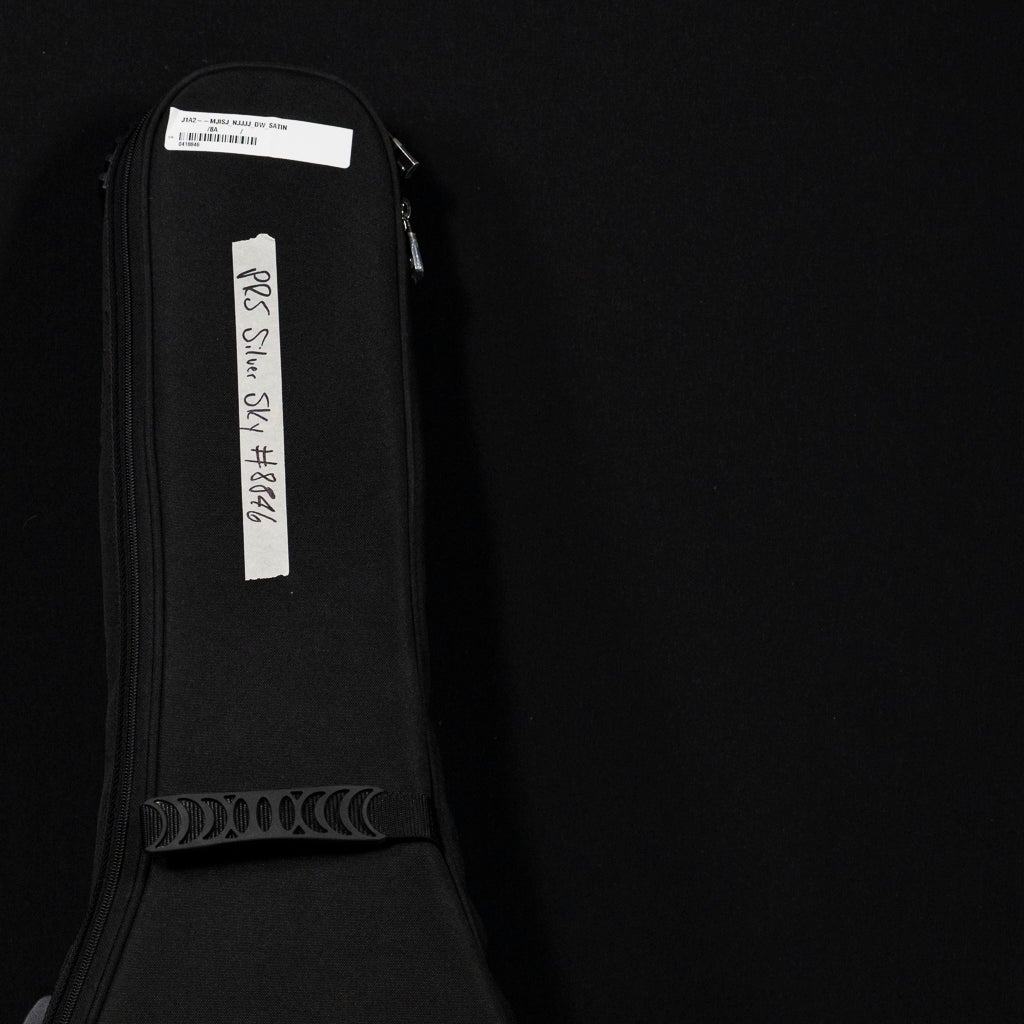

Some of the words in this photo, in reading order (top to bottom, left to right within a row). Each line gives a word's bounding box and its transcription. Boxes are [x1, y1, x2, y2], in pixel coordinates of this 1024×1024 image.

[237, 268, 272, 316] PRS
[242, 327, 269, 379] Silver
[244, 445, 278, 523] #8846
